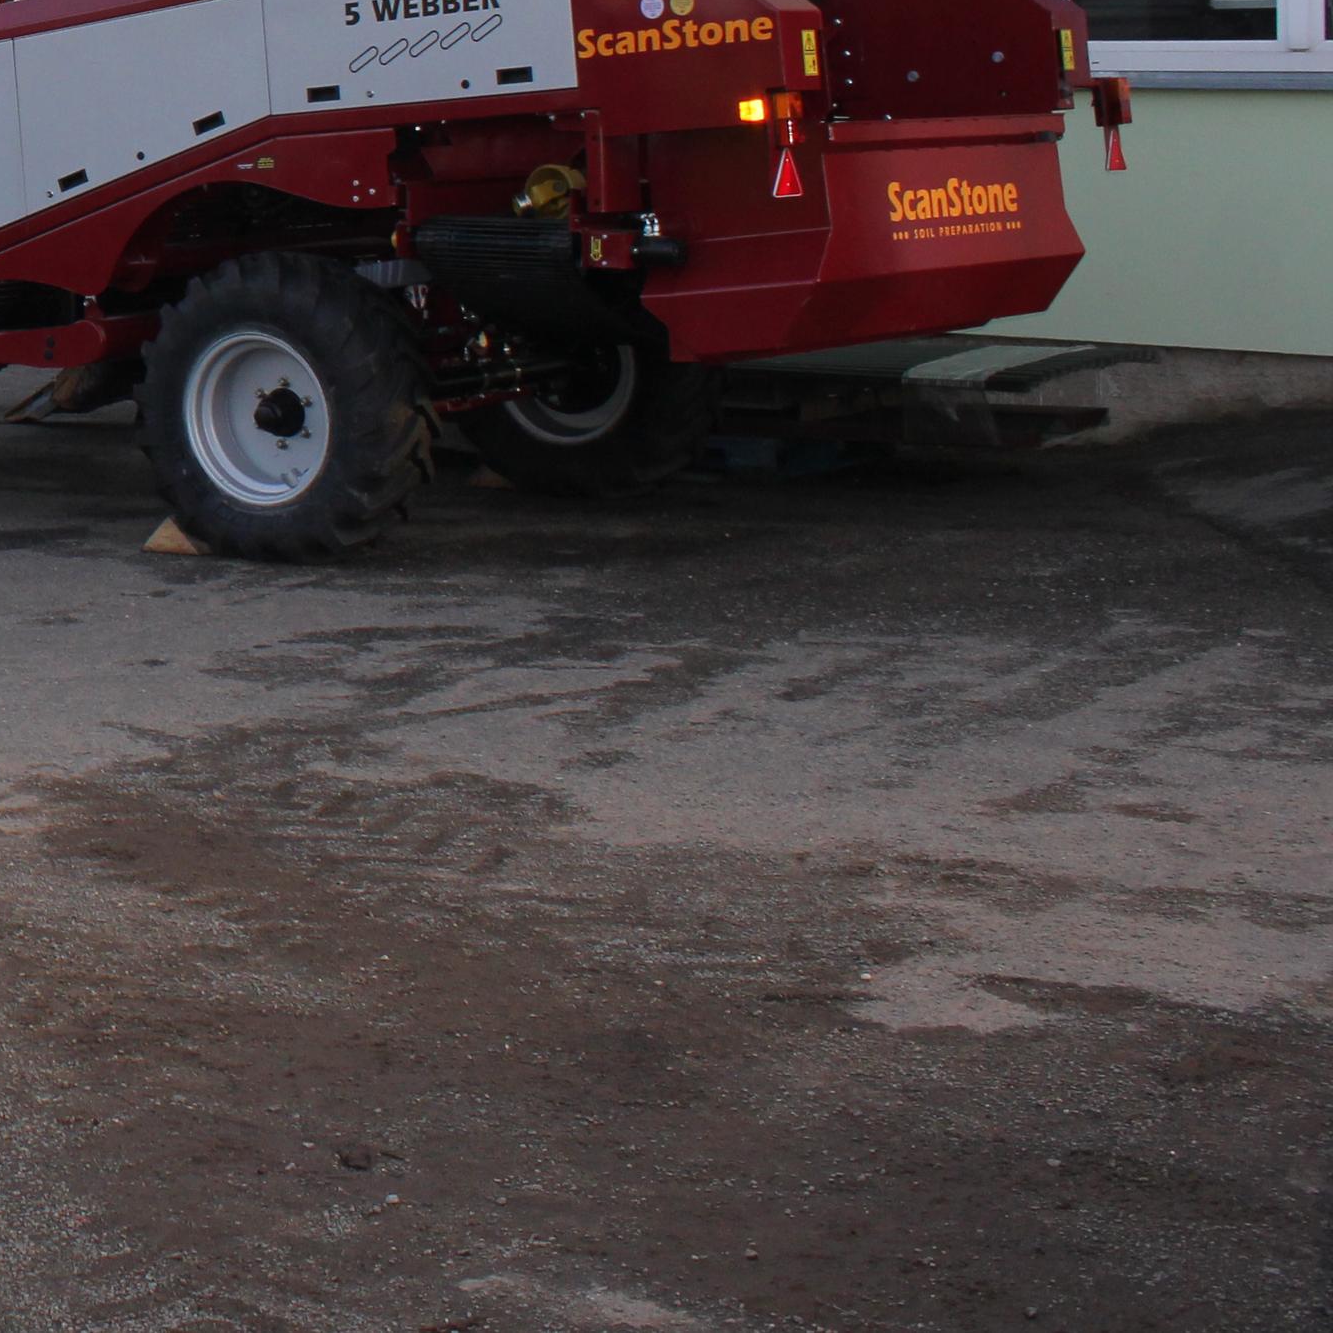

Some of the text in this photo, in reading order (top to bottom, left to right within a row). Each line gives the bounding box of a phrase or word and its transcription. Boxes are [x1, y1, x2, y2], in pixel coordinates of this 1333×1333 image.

[345, 2, 361, 26] 5
[577, 16, 774, 59] ScanStone
[887, 177, 1018, 222] ScanStone
[914, 221, 1003, 240] SOIL PREPARATION
